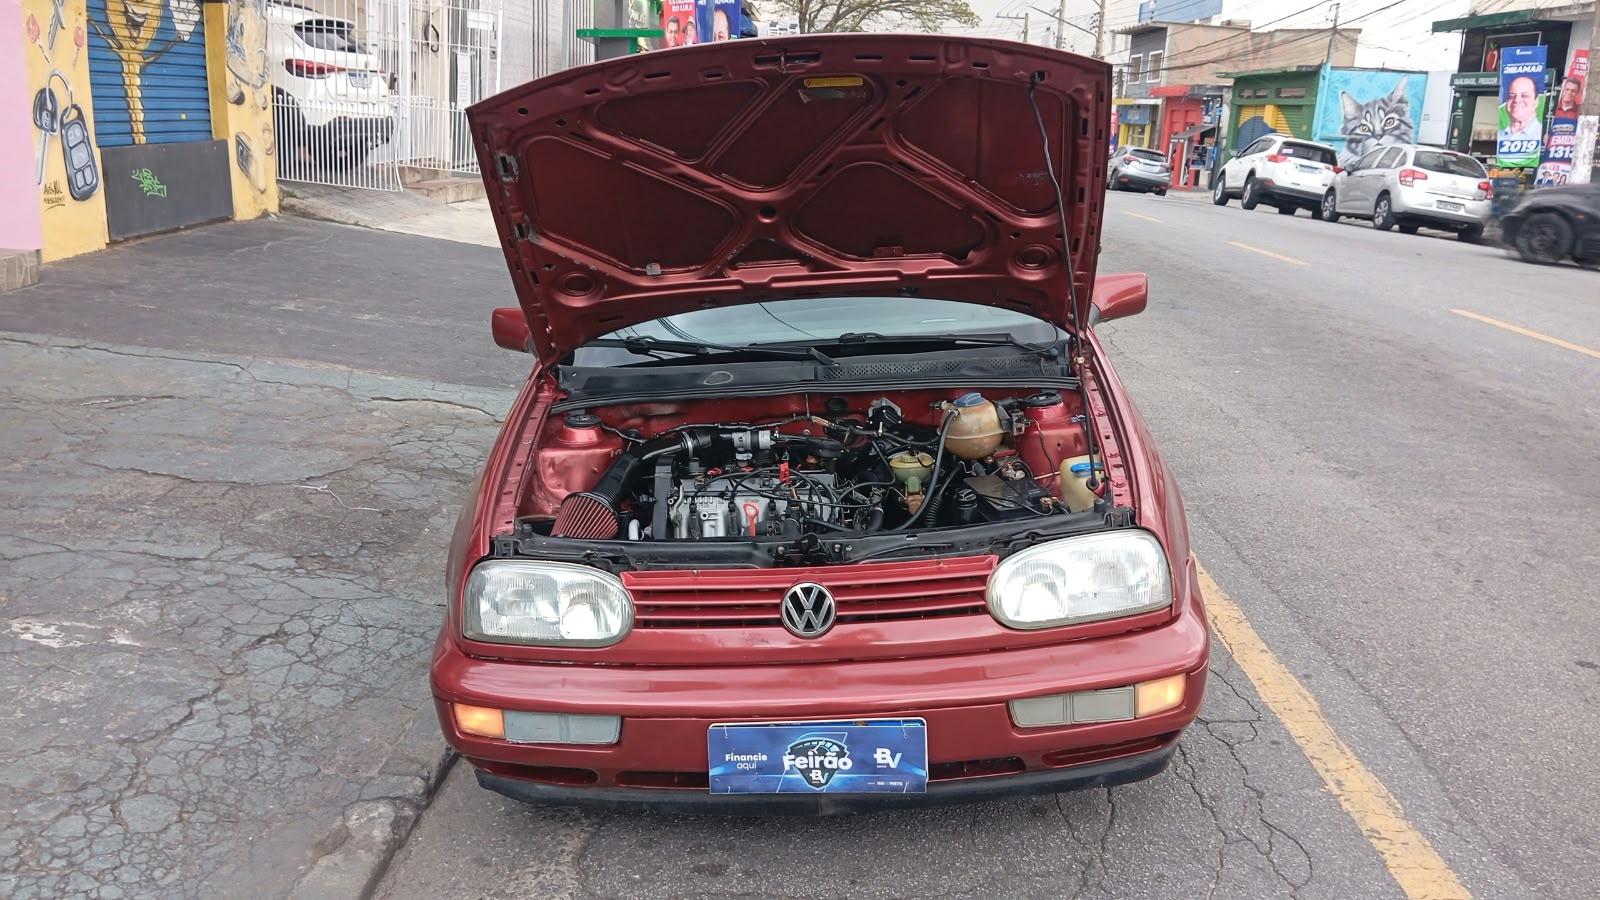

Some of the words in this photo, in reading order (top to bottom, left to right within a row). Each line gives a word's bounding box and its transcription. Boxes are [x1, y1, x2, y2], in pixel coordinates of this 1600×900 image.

[1503, 65, 1543, 74] RIBAMAR
[1500, 140, 1538, 153] 2019
[725, 752, 768, 762] Financie
[782, 751, 853, 770] Feirão
[873, 748, 903, 769] BV
[736, 761, 757, 771] aqui
